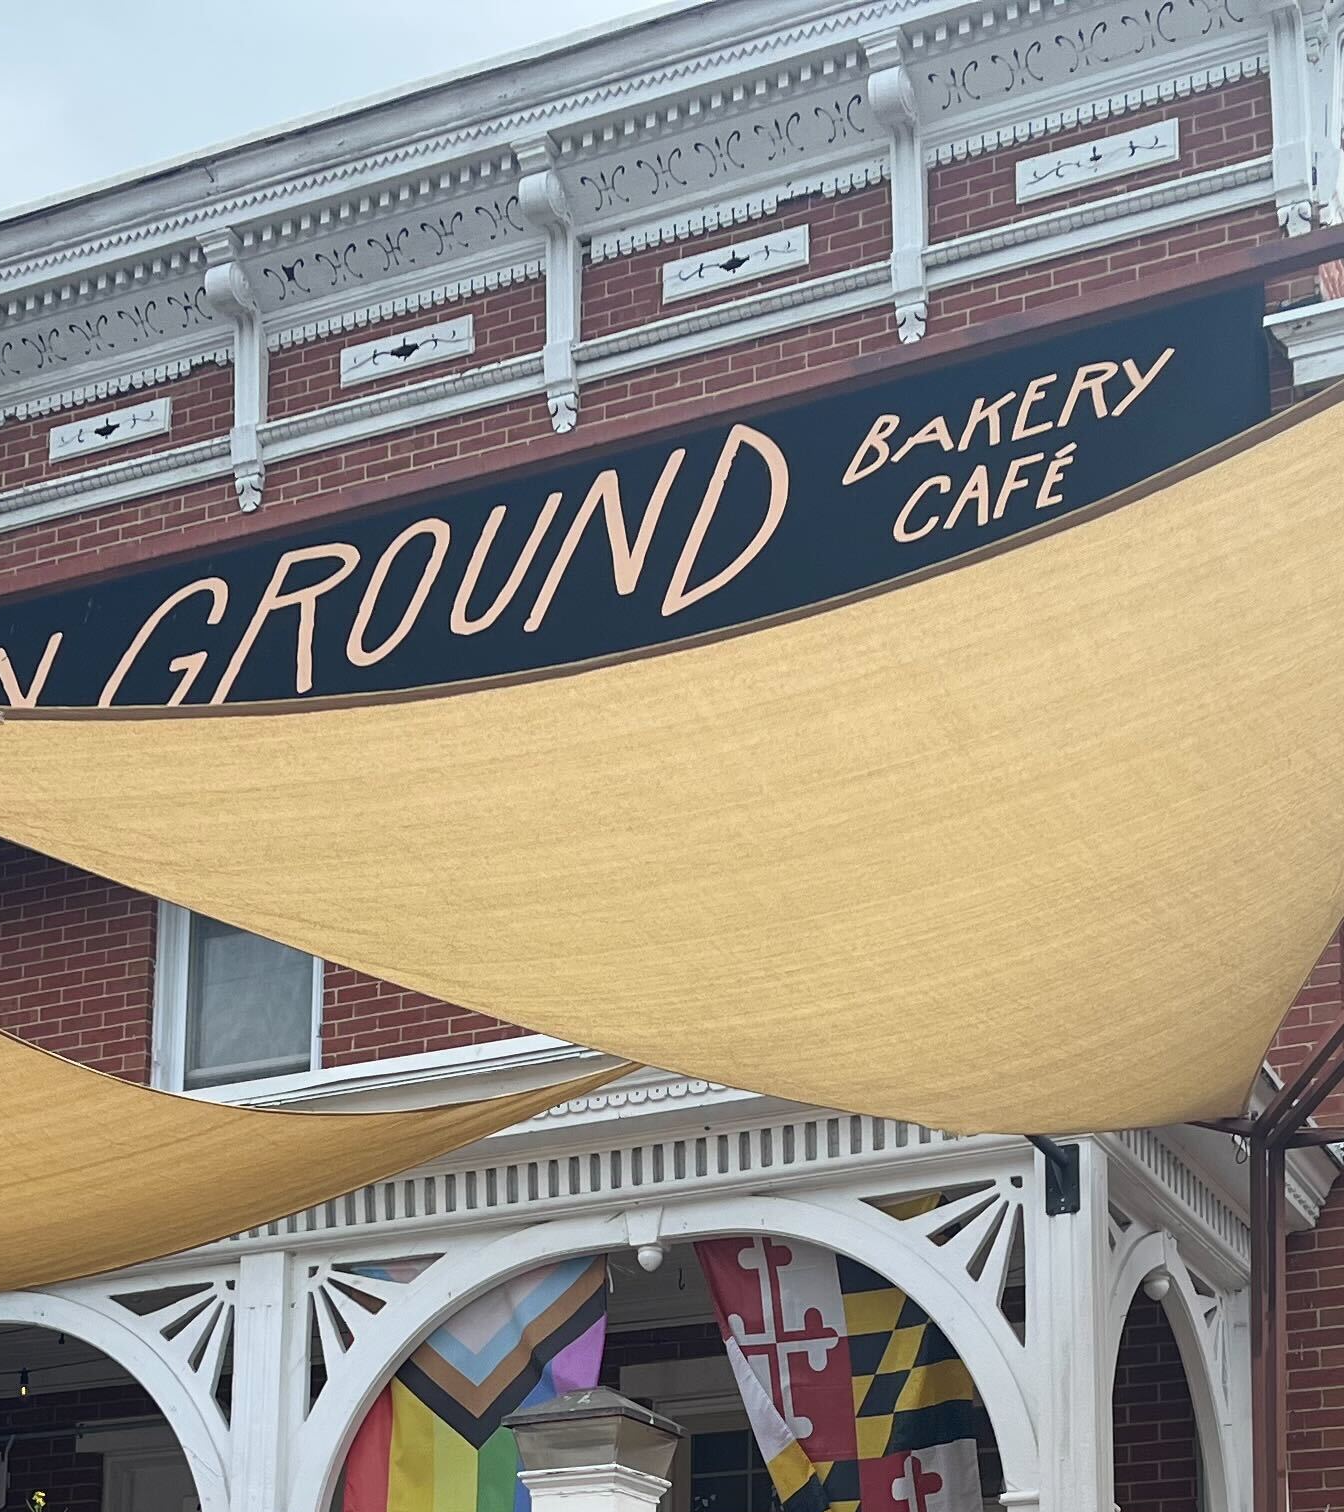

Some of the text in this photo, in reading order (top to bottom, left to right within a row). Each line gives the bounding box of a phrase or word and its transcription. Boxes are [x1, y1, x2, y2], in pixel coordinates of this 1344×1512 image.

[841, 347, 1175, 484] BAKERY
[892, 442, 1074, 544] CAFÉ
[98, 424, 789, 707] GROUND
